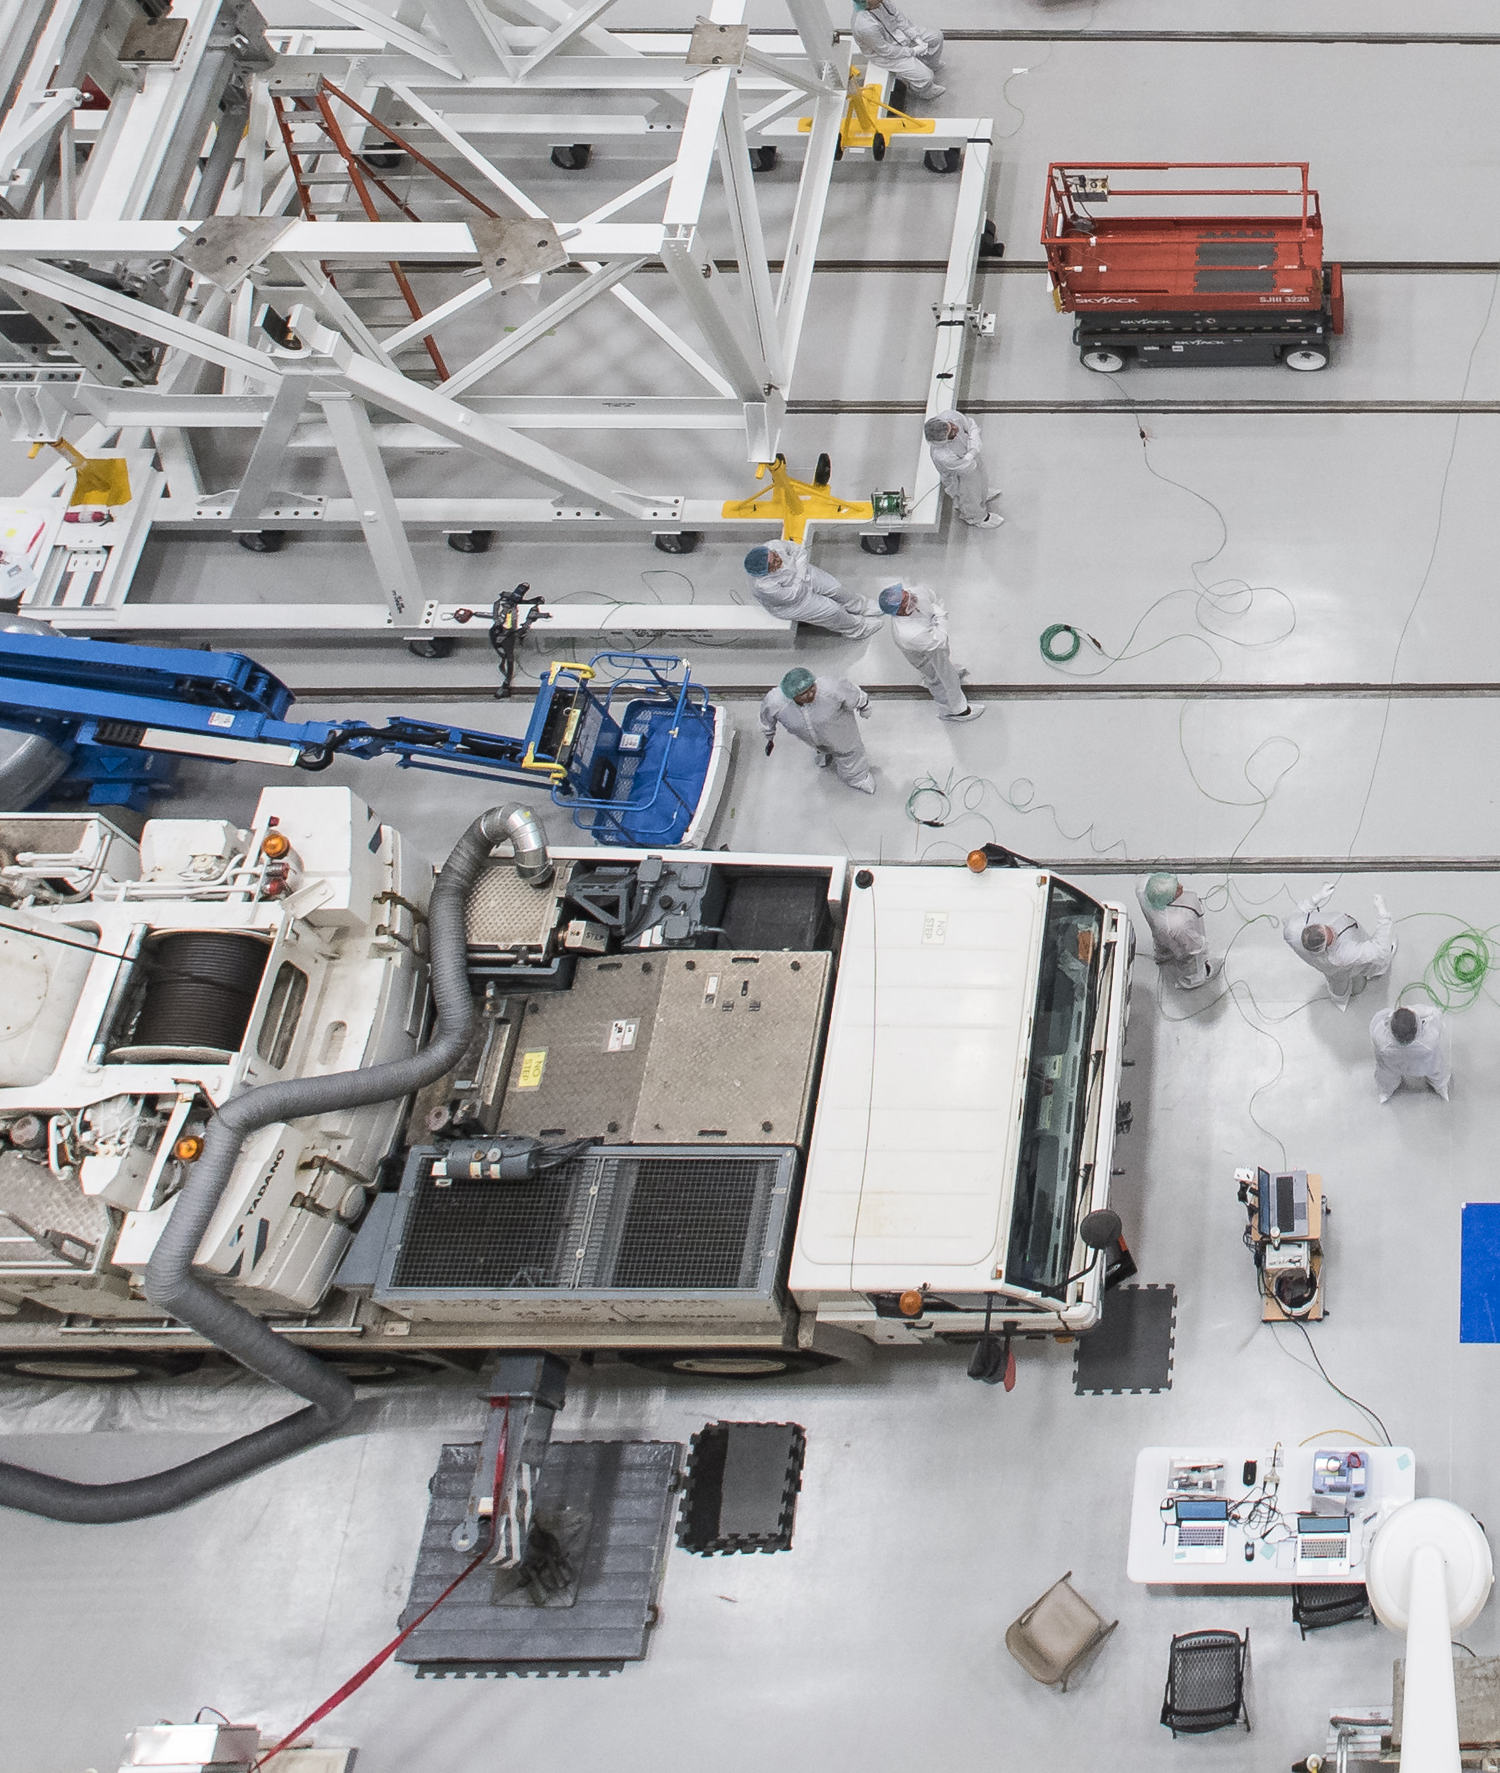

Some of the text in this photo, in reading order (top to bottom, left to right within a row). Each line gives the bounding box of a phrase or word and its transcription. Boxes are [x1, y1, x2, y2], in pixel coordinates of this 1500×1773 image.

[1075, 295, 1139, 304] SKYJACK
[926, 917, 935, 939] STEP
[935, 920, 946, 937] NO
[522, 1058, 532, 1081] STEP
[532, 1060, 542, 1078] NO
[246, 1148, 286, 1217] TADANO
